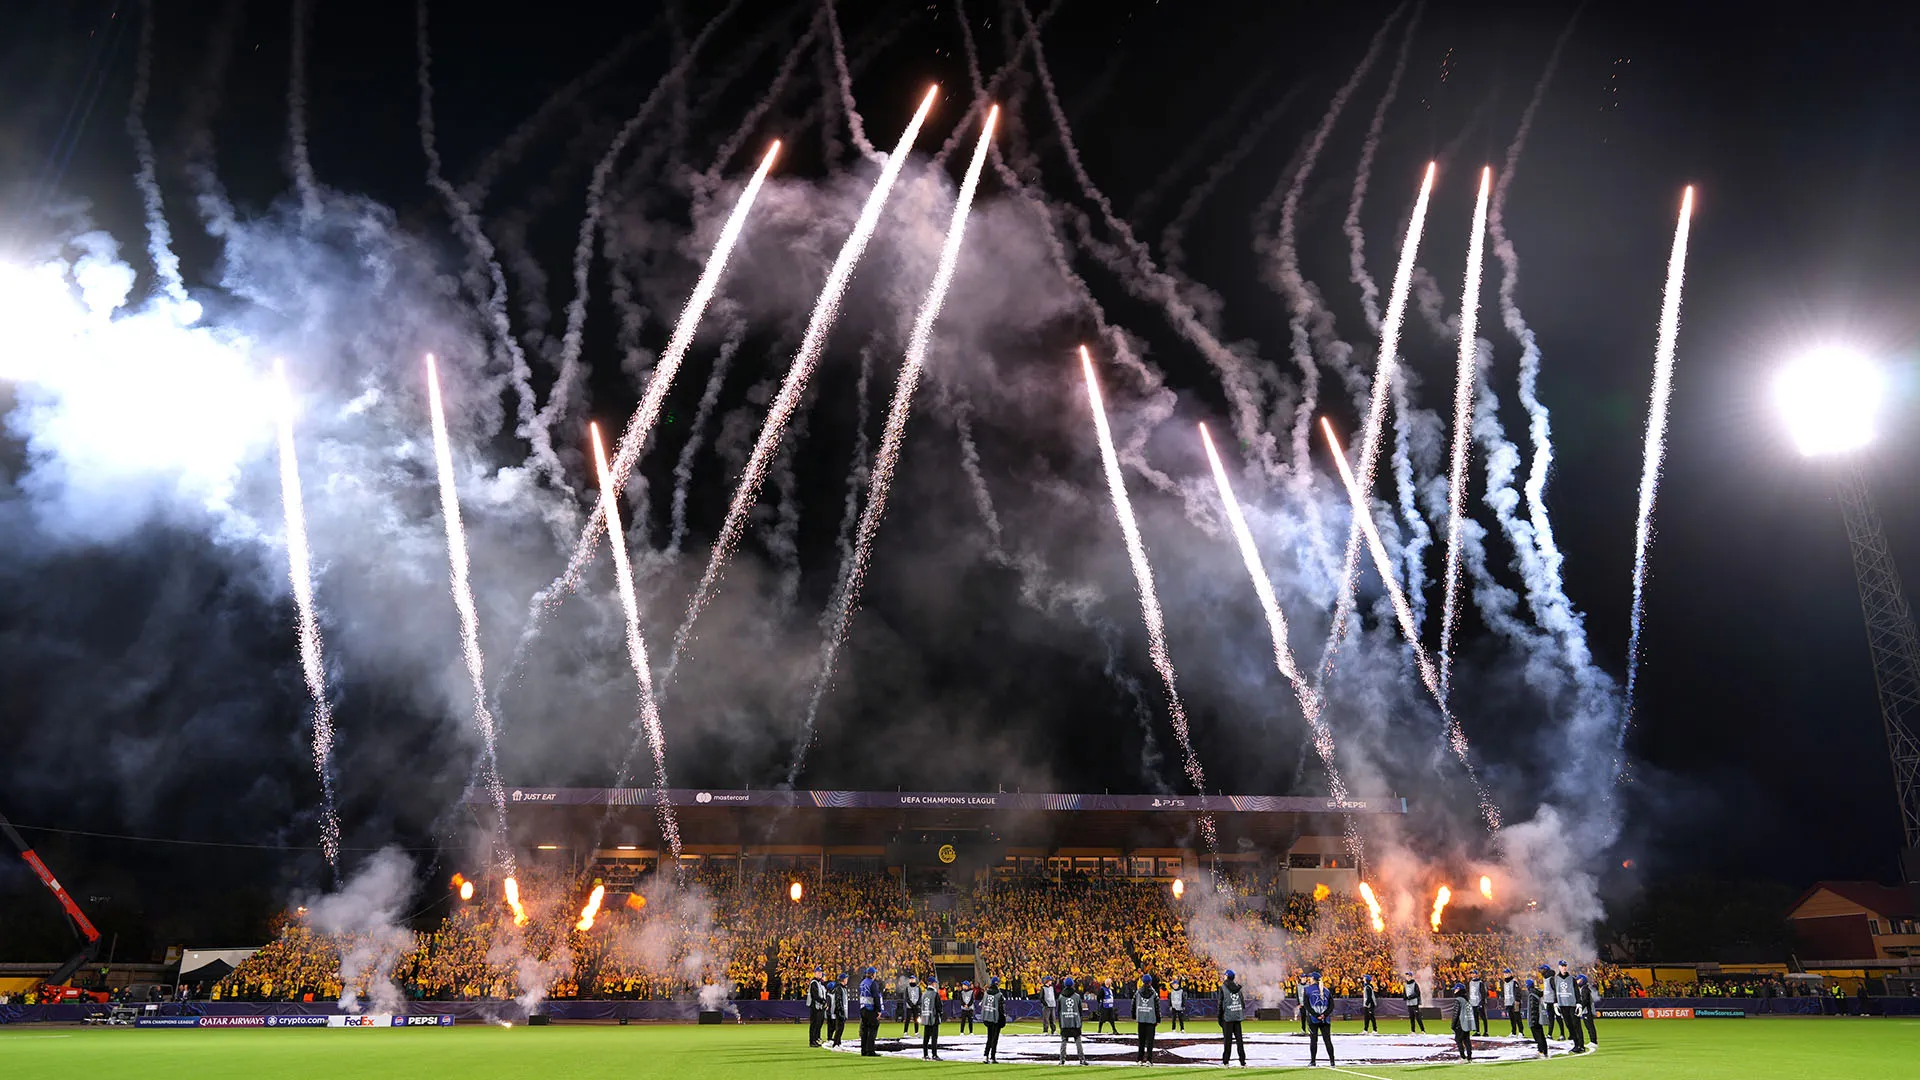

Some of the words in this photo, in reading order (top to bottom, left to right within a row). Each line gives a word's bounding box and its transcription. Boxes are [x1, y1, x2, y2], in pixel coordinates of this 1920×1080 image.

[523, 793, 541, 801] JUST
[542, 793, 557, 801] EAT
[901, 796, 920, 804] UEFA
[922, 796, 965, 804] CHAMPIONS
[968, 797, 995, 805] LEAGUE
[1342, 801, 1367, 809] PEPSI
[1602, 1009, 1642, 1017] mastercard
[1656, 1009, 1674, 1017] JUST
[1675, 1009, 1690, 1017] EAT
[199, 1017, 228, 1026] QATAR
[229, 1017, 265, 1025] AIRWAYS
[278, 1017, 325, 1026] crypto.com
[344, 1016, 375, 1026] FedEx
[407, 1017, 438, 1025] PEPSI
